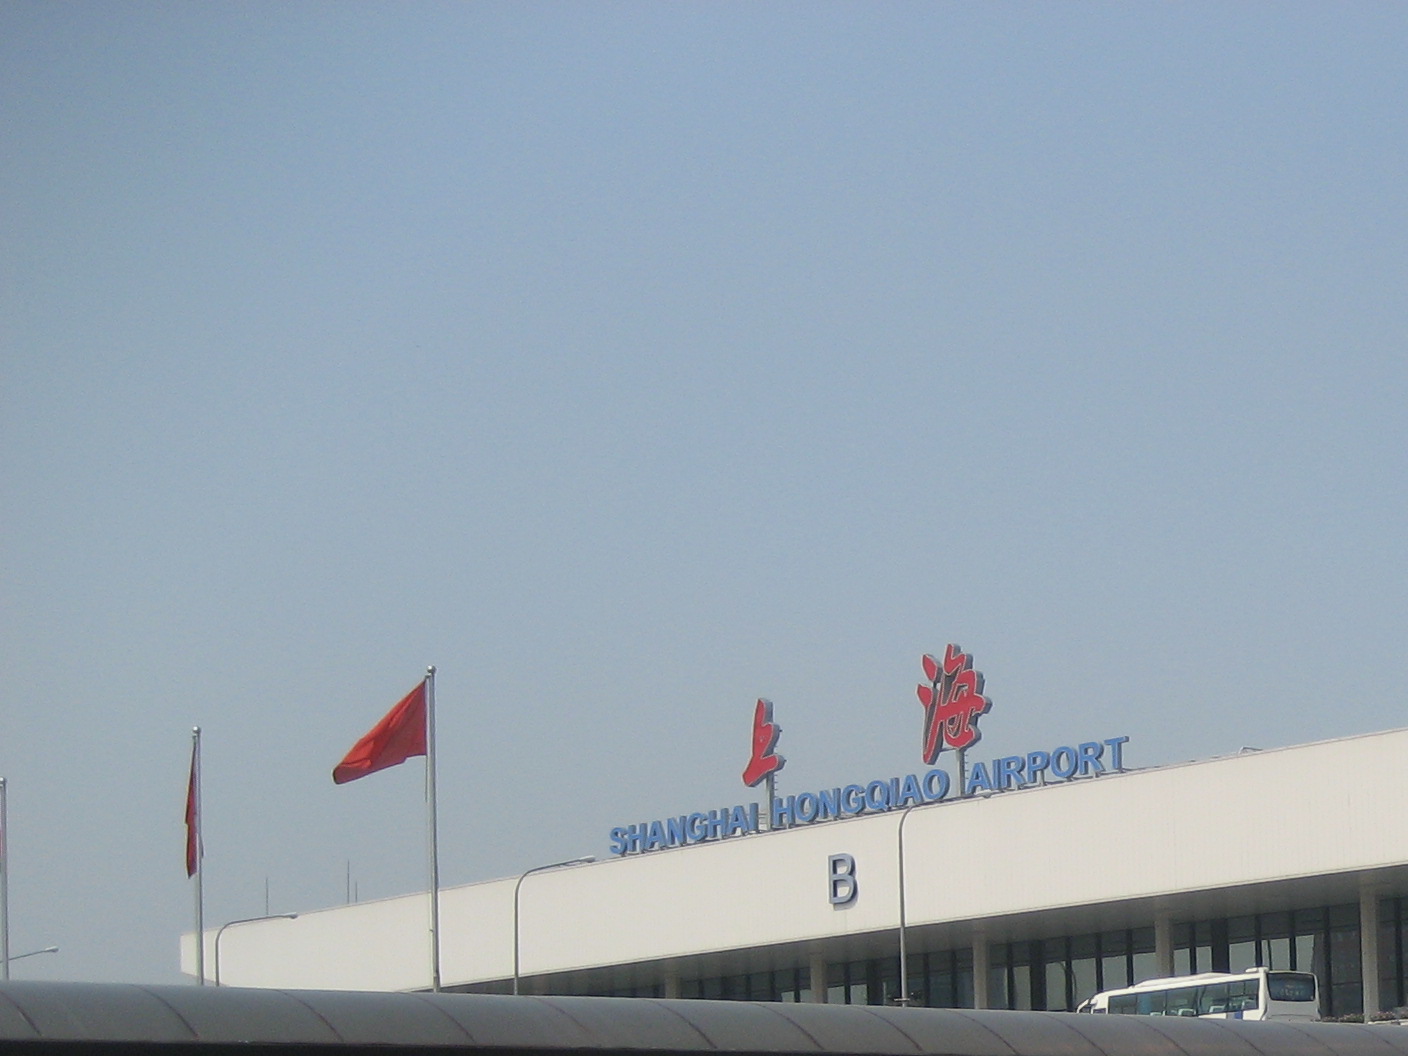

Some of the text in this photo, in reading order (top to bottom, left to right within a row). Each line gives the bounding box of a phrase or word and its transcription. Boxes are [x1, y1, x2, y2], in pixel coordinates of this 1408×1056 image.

[609, 736, 1129, 857] SHANGHAI HONGQIAO AIRPORT
[828, 853, 859, 906] B
